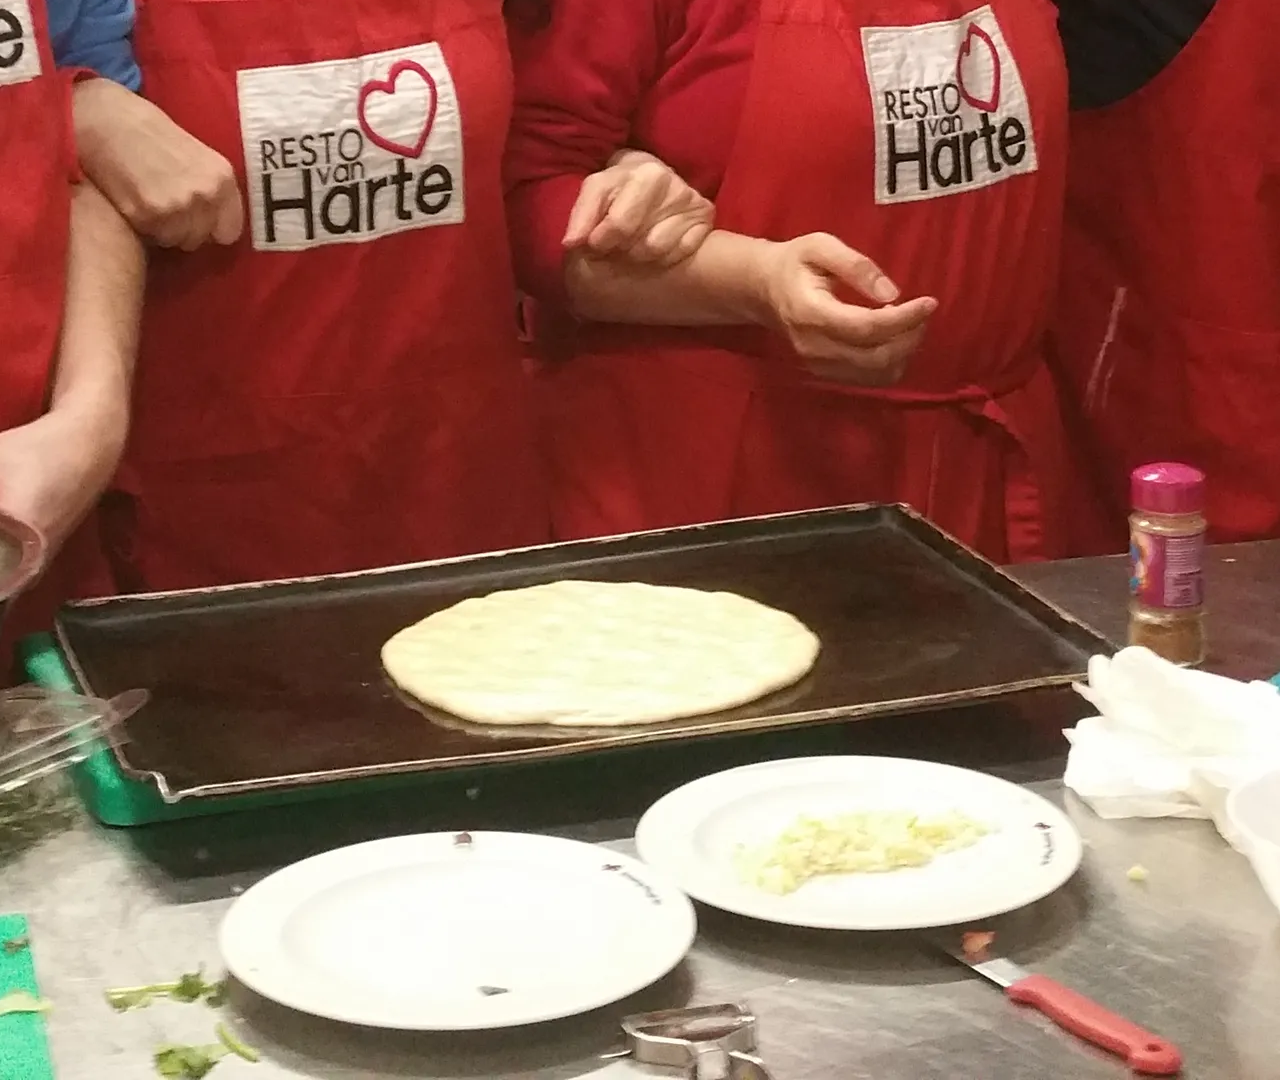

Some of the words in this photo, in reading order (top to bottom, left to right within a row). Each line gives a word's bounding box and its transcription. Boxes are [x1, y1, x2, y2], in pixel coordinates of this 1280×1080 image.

[884, 83, 961, 121] RESTO
[927, 115, 963, 137] van
[260, 128, 363, 171] RESTO
[887, 112, 1026, 195] Harte
[317, 161, 365, 185] van
[262, 158, 453, 243] Harte
